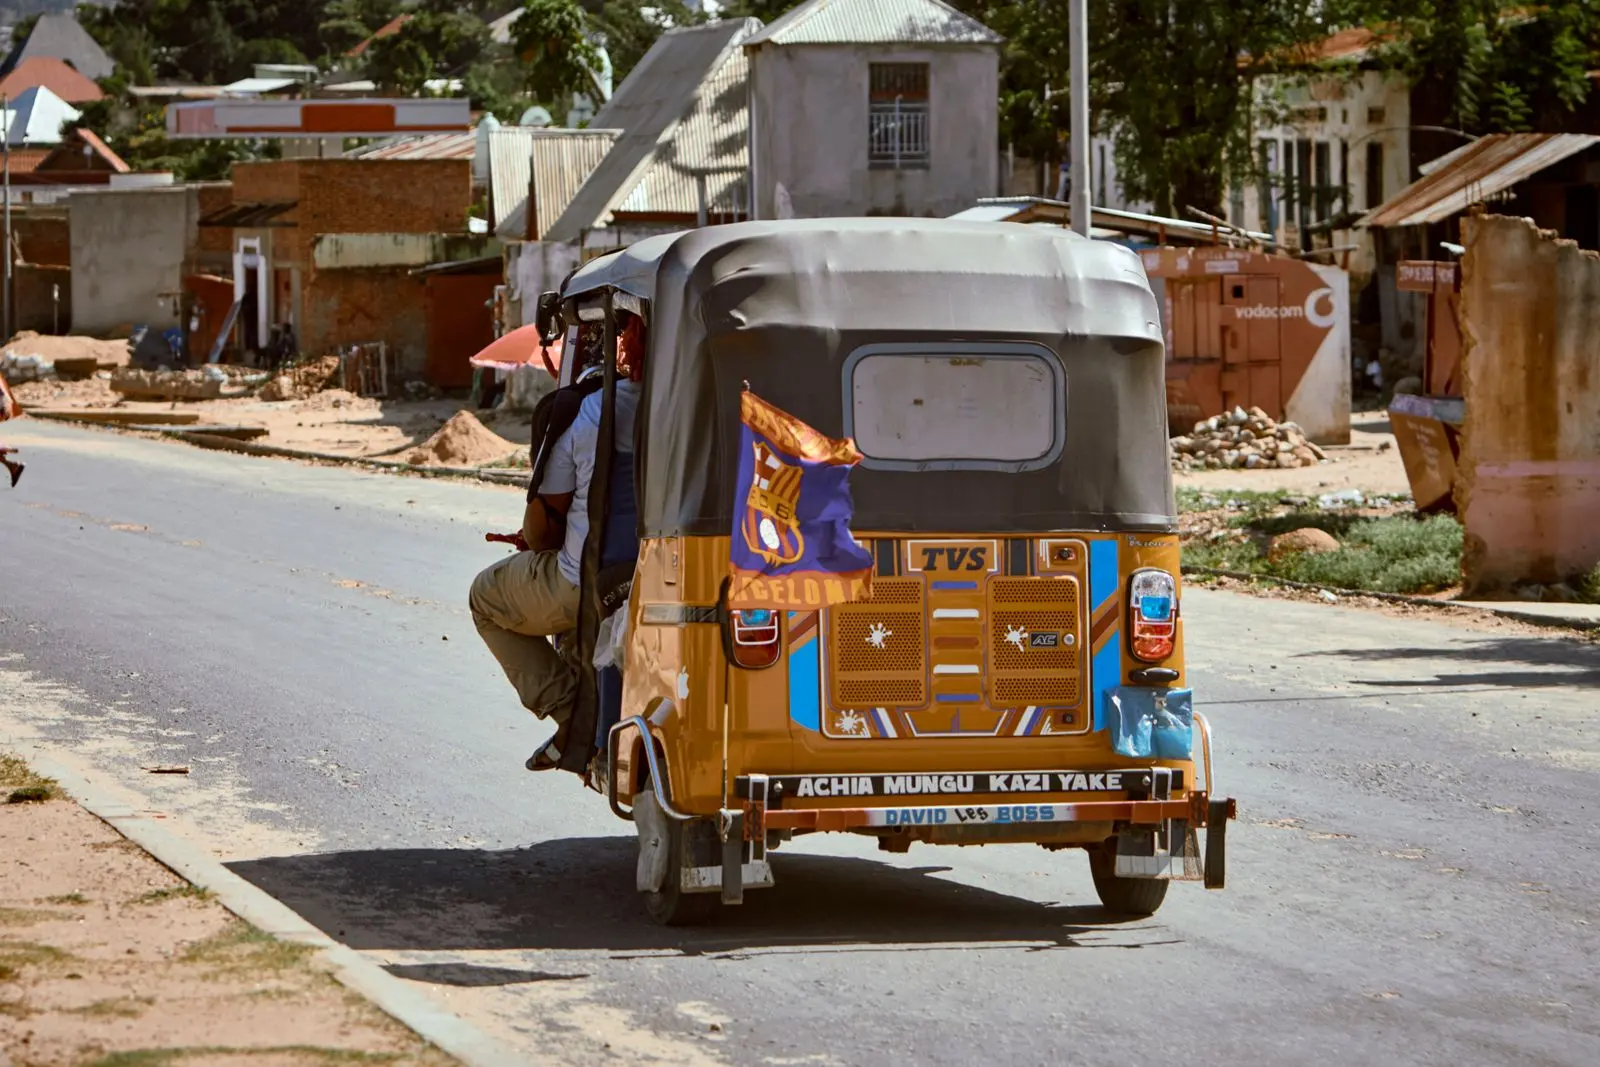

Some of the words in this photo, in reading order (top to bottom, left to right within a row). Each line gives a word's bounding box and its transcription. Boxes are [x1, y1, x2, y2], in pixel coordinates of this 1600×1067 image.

[922, 547, 987, 571] TVS
[797, 776, 874, 797] ACHIA
[883, 774, 974, 794] MUNGU
[989, 774, 1050, 792] KAZI
[1057, 773, 1123, 791] YAKE
[885, 808, 948, 825] DAVID
[997, 805, 1055, 823] BOSS
